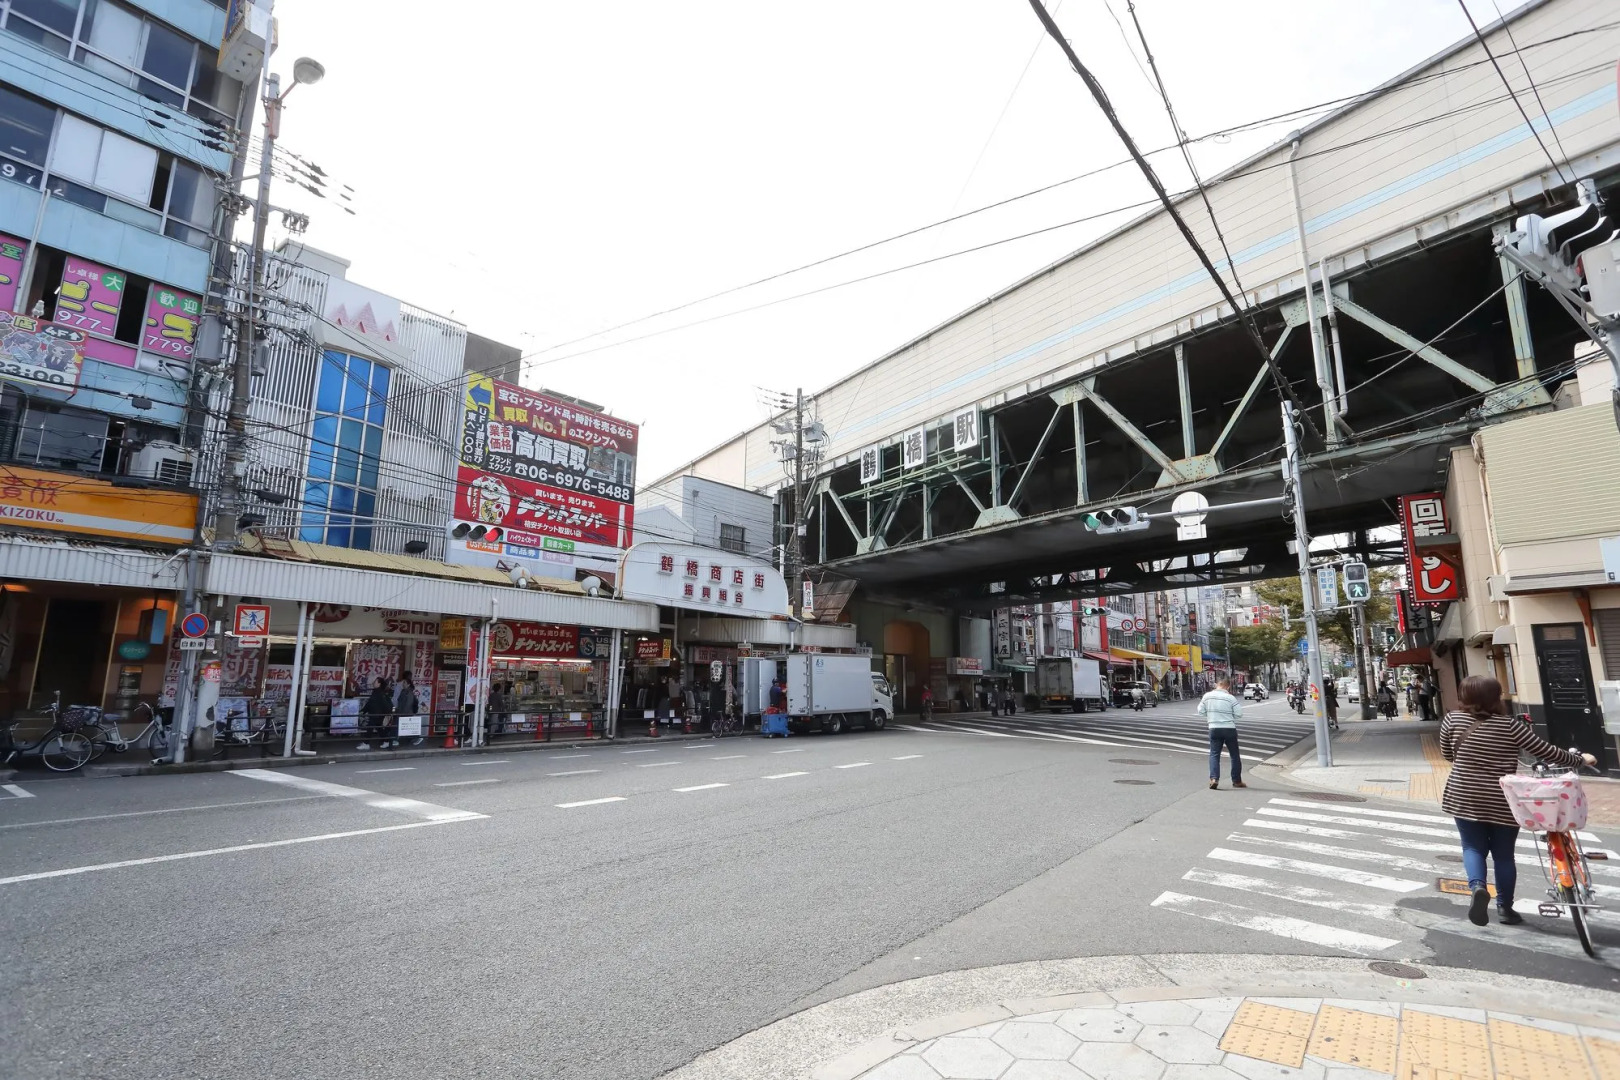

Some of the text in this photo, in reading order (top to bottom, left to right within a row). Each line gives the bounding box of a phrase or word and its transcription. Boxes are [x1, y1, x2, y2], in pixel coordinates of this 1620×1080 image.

[106, 275, 121, 291] 大
[159, 291, 198, 314] 歓迎
[503, 406, 528, 422] 買取
[489, 454, 512, 465] ブランド
[515, 430, 587, 472] 高価買取
[862, 410, 976, 479] 鶴橋駅
[529, 465, 630, 500] 06-6976-5488
[661, 555, 764, 589] 鶴橋商店街
[684, 583, 743, 604] 振興組合
[514, 637, 574, 652] チケットスーパー
